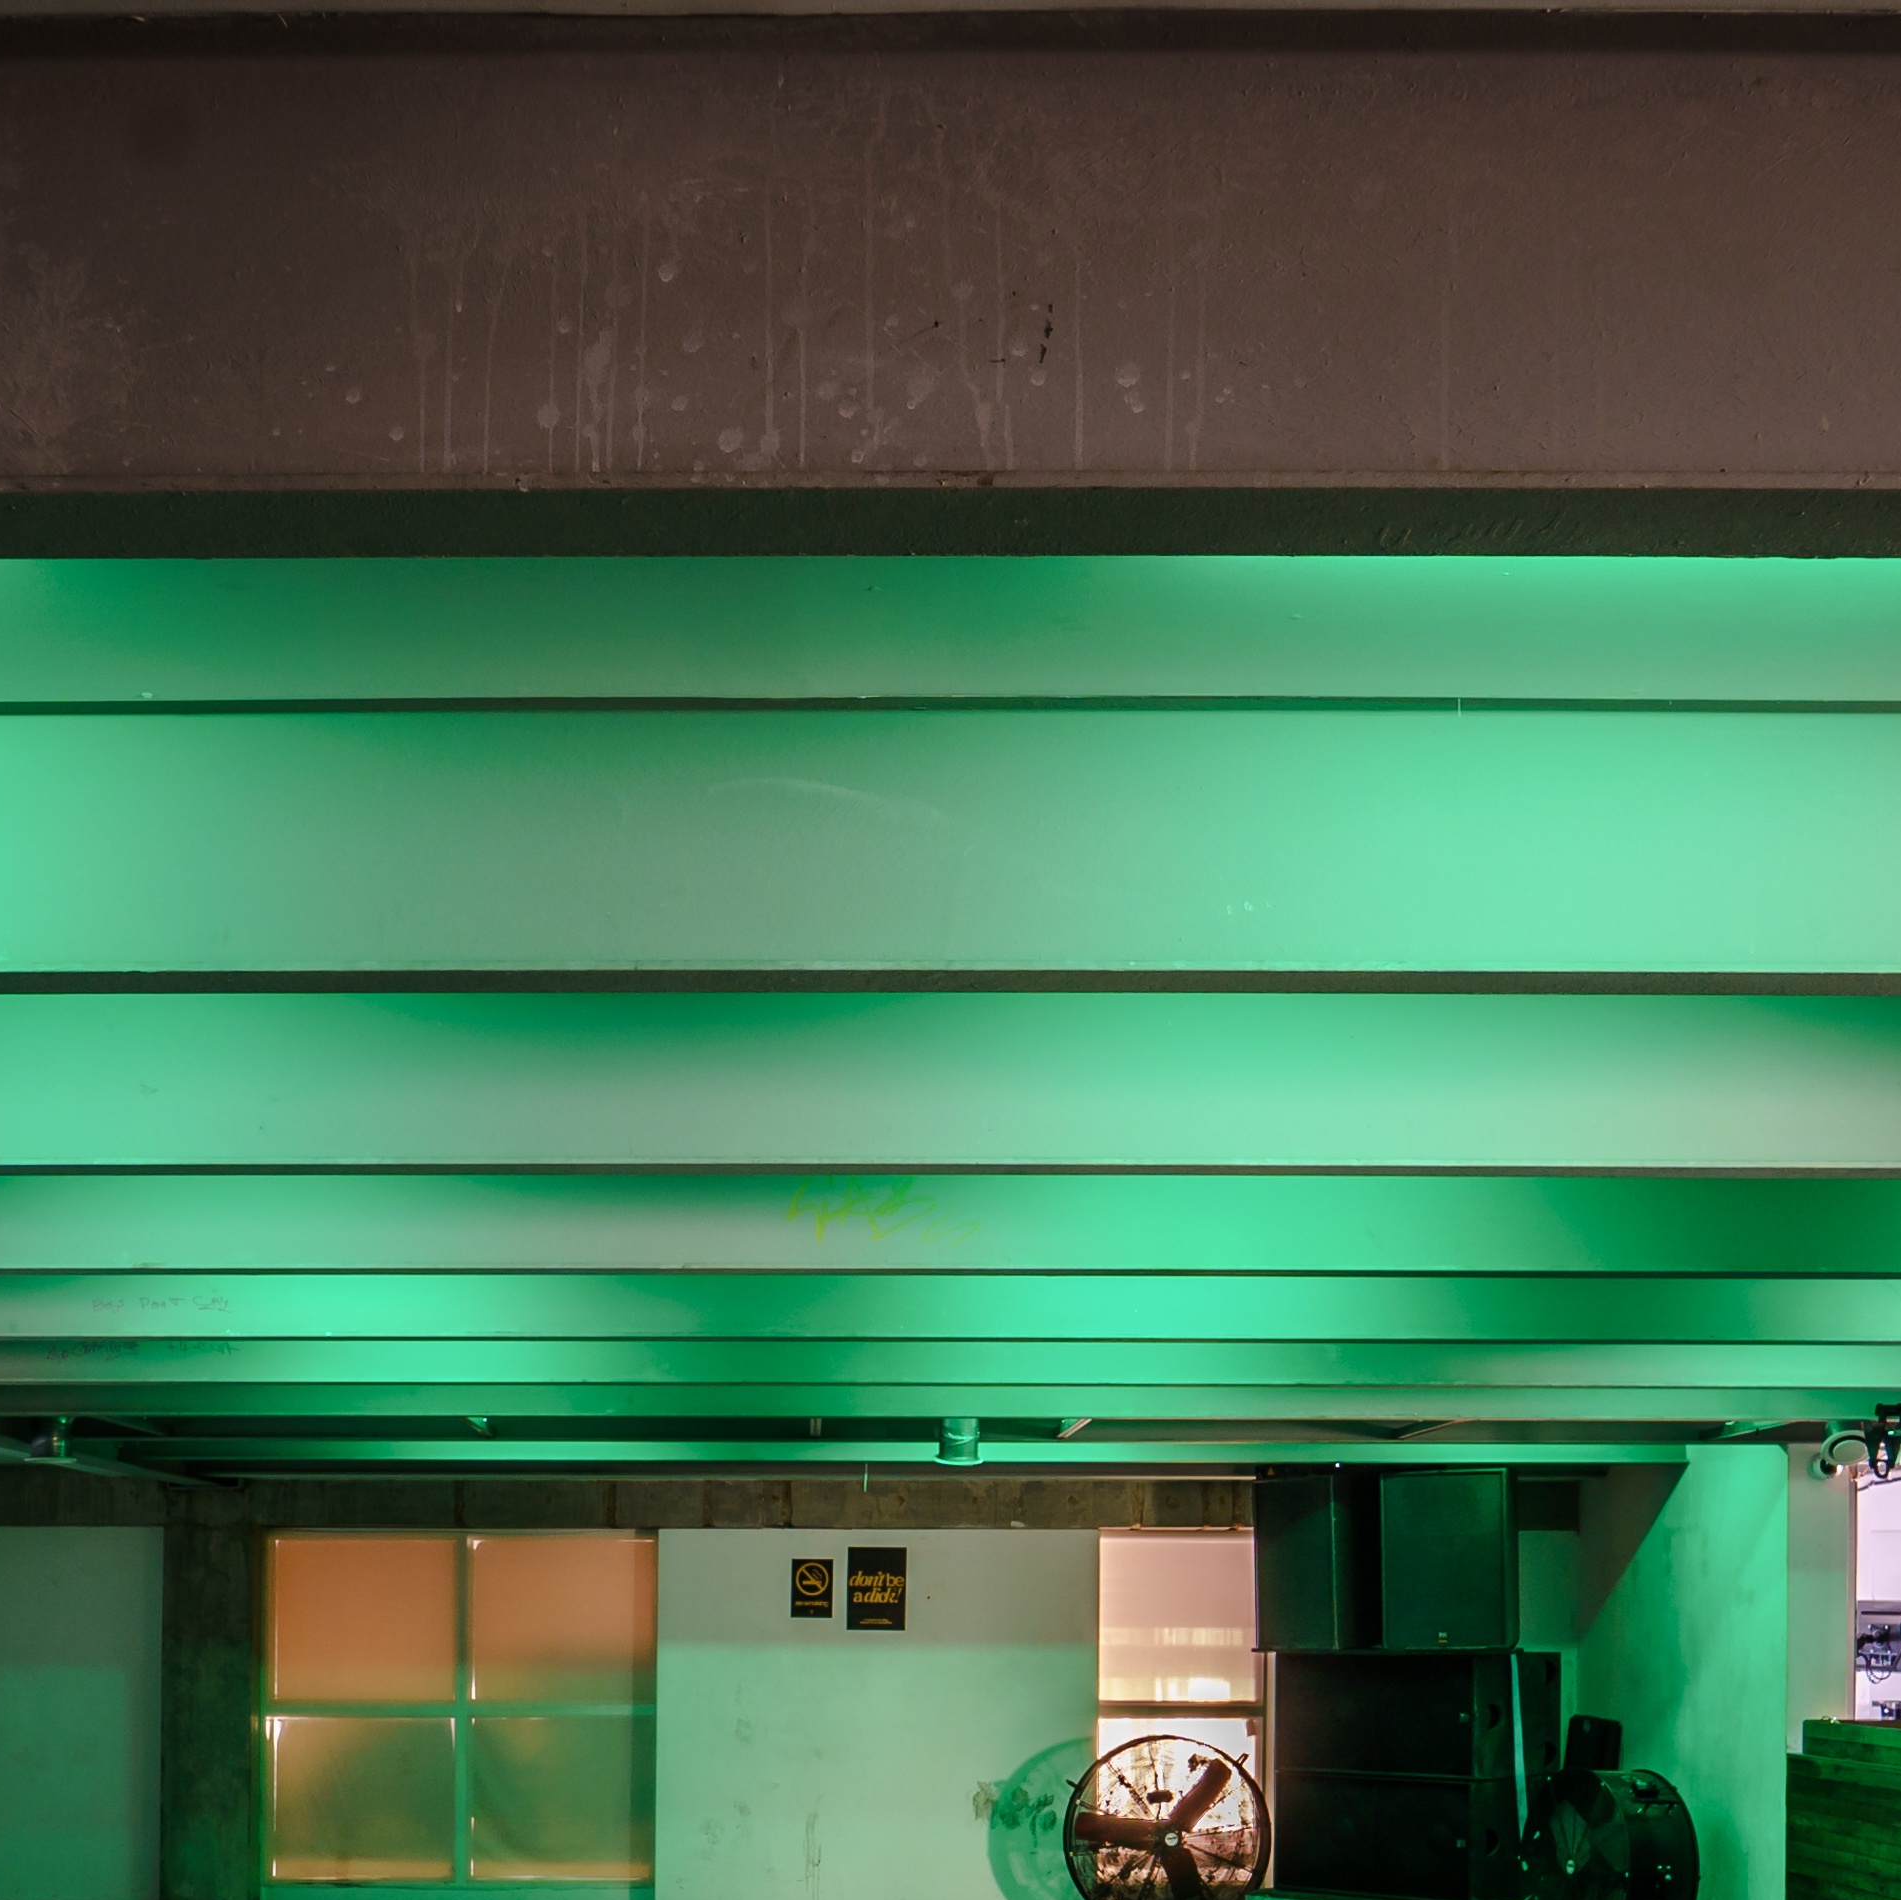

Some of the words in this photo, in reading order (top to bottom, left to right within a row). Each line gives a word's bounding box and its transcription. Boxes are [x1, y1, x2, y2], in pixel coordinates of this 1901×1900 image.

[849, 1570, 886, 1587] don't
[886, 1573, 905, 1587] be
[854, 1592, 862, 1603] a
[863, 1587, 903, 1604] dick!
